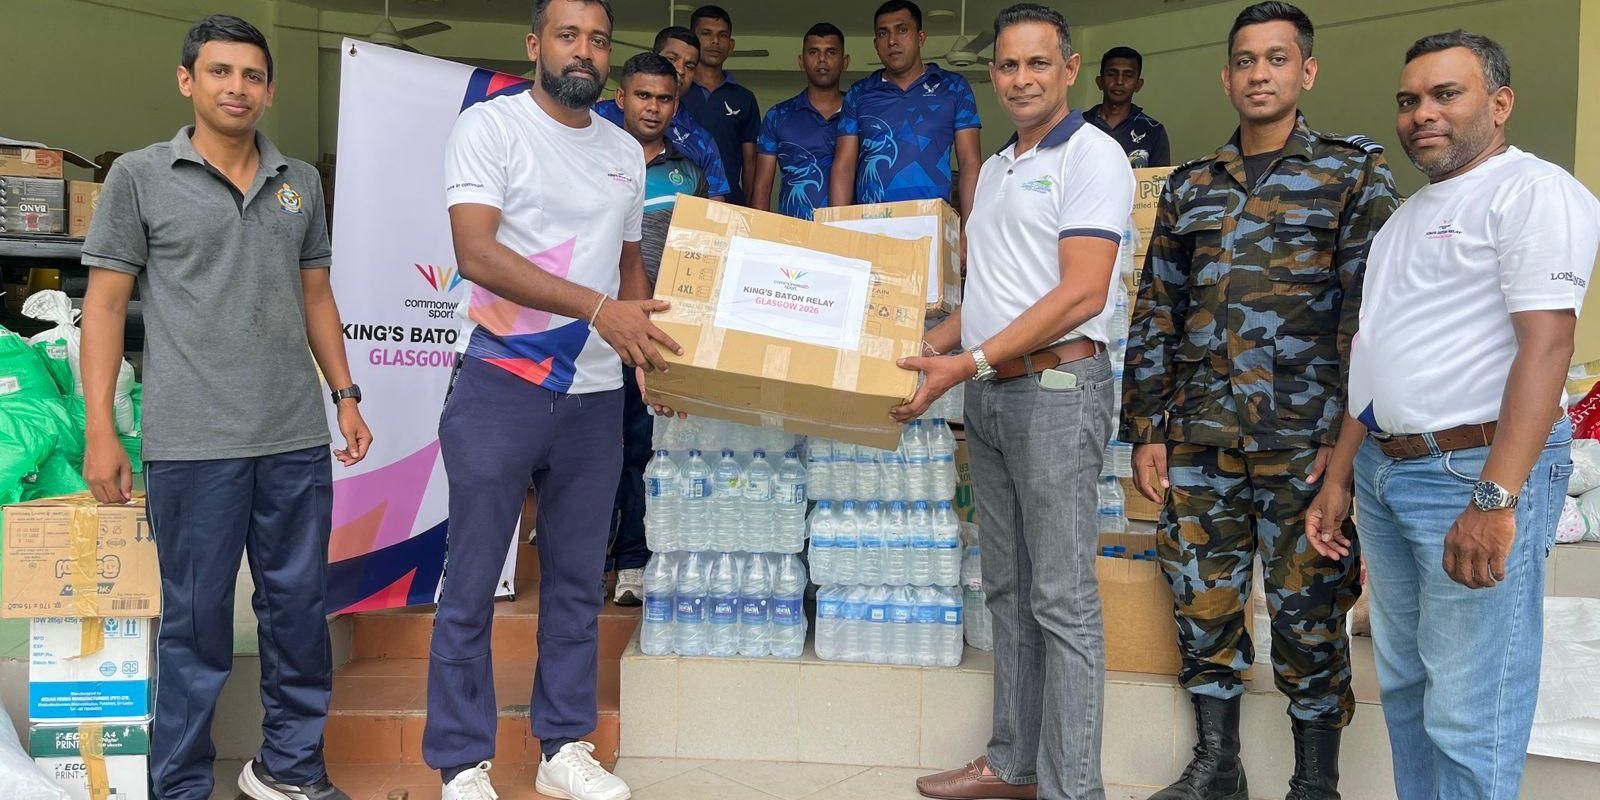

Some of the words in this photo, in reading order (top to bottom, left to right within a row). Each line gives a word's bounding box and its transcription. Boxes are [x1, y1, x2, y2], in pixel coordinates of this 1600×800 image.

[684, 250, 702, 260] 2XS
[686, 267, 692, 276] L
[677, 285, 694, 295] 4XL
[743, 286, 773, 297] KING'S
[775, 291, 804, 303] BATON
[806, 296, 835, 308] RELAY
[755, 296, 798, 311] GLASGOW
[799, 303, 820, 315] 2026
[428, 308, 454, 319] sport
[342, 323, 404, 343] KING'S
[410, 327, 461, 345] BATO
[369, 348, 456, 368] GLASGOW
[65, 732, 89, 740] ECO
[56, 740, 80, 749] PRINT
[56, 771, 79, 780] PRINT
